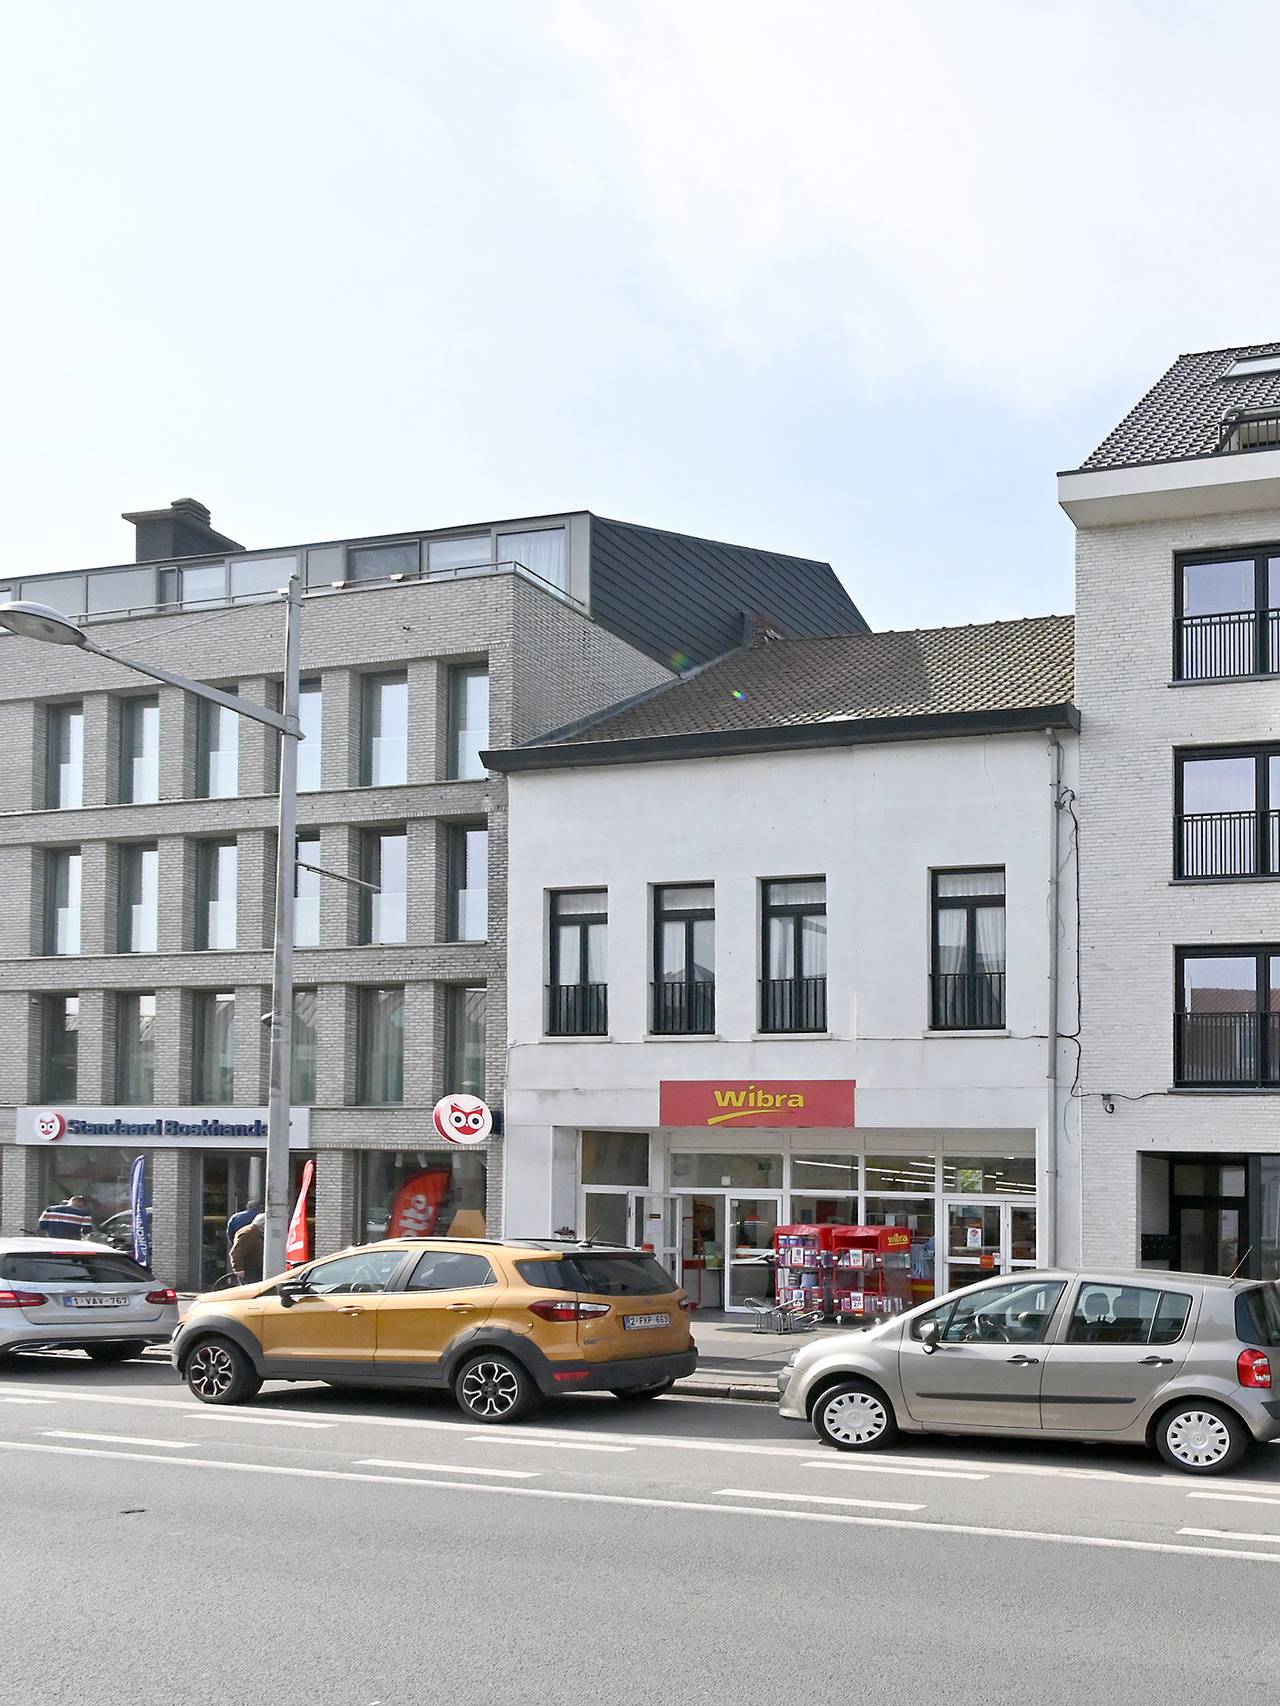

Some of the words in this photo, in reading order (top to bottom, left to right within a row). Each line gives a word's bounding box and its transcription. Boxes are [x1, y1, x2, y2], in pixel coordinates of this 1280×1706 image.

[713, 1085, 805, 1108] Wibra
[67, 1118, 163, 1136] Standaard
[164, 1117, 269, 1136] Boekhande
